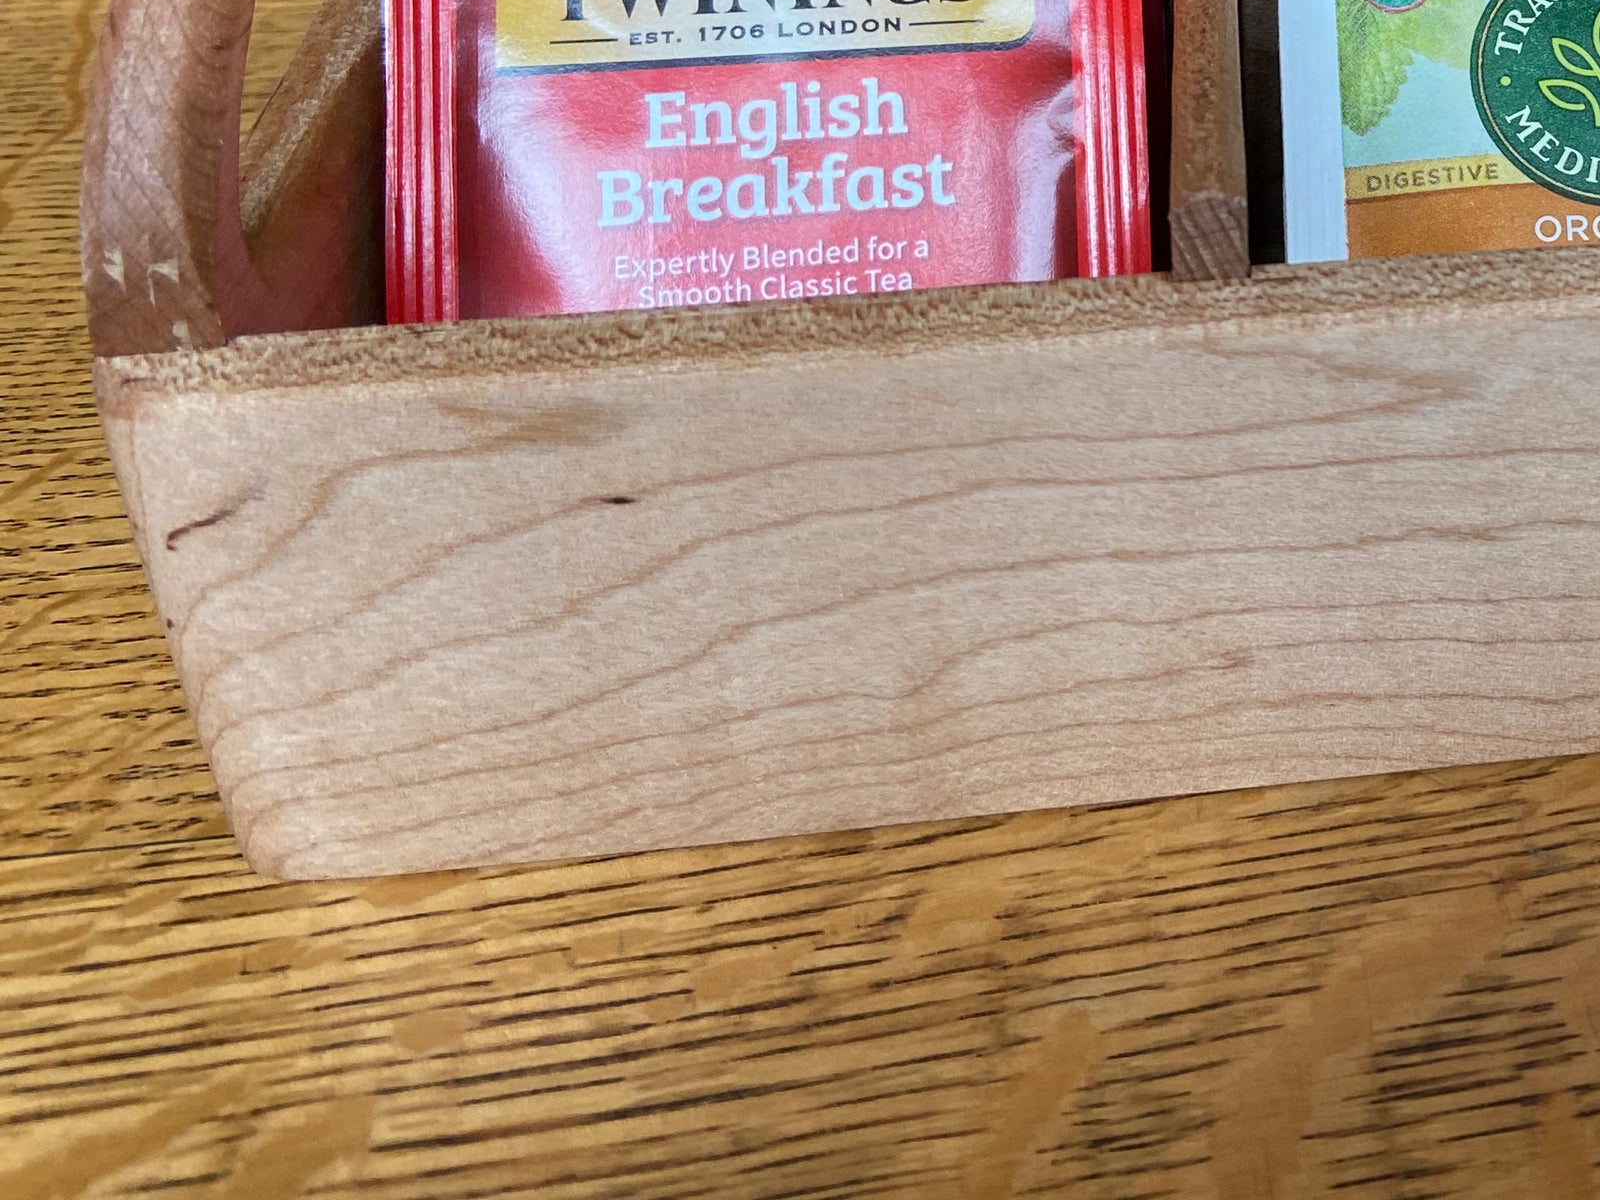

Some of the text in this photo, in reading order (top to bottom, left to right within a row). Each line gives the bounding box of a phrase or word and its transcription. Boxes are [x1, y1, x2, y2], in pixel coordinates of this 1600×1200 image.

[629, 17, 901, 46] EST. 1706 LONDON
[644, 77, 908, 159] English
[597, 152, 955, 227] Breakfast
[1366, 162, 1499, 192] DIGESTIVE
[614, 236, 929, 282] Expertly Blended for a
[639, 269, 913, 308] Smooth Classic Tea
